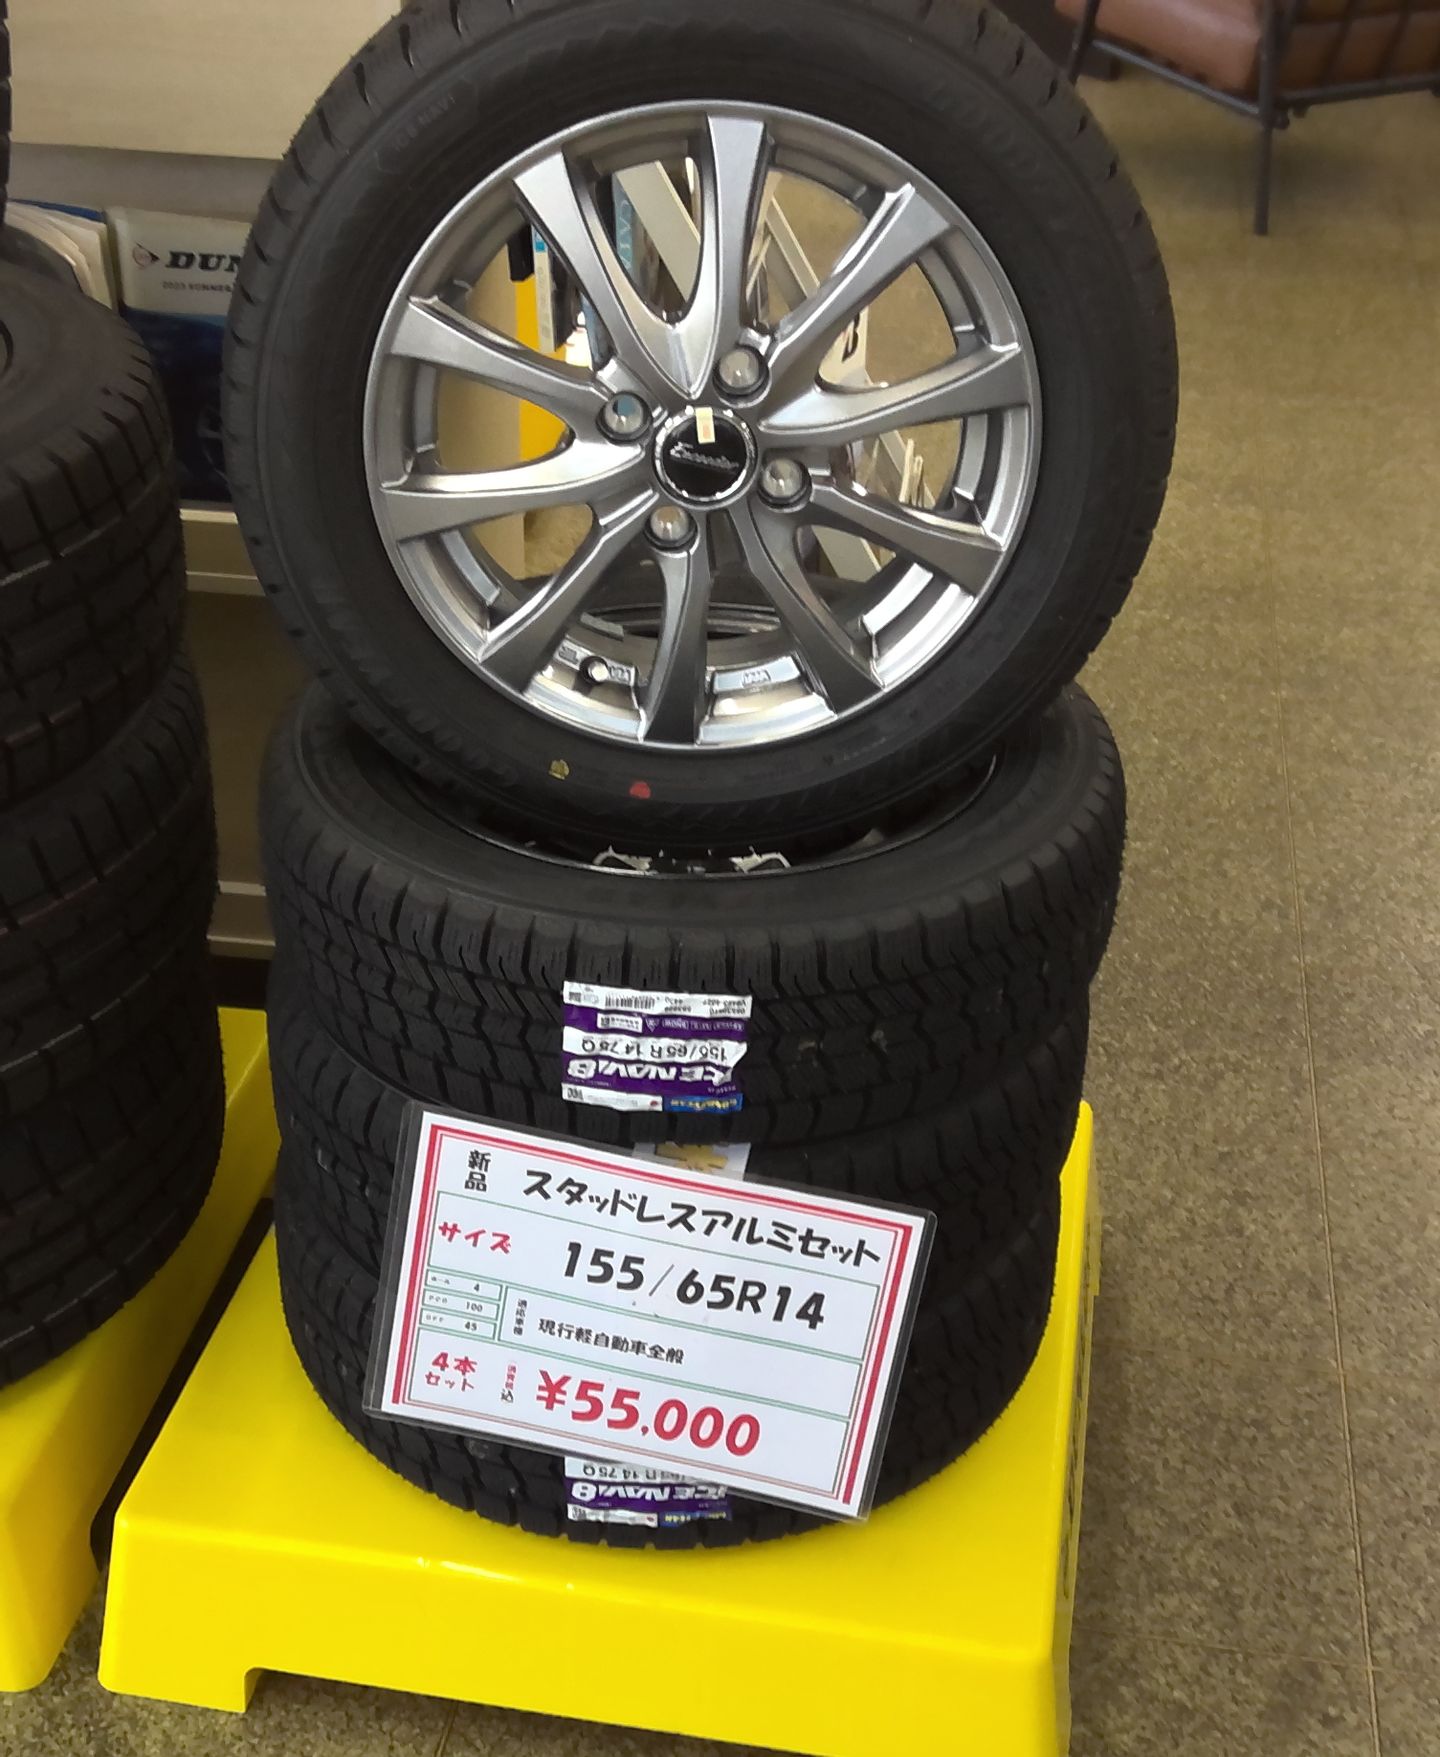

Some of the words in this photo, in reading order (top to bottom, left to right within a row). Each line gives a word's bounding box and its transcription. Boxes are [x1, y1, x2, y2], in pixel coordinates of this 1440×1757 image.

[464, 1149, 492, 1193] 新品
[523, 1168, 881, 1267] スタッドレスアルミセット
[438, 1221, 512, 1255] サイズ
[465, 1302, 484, 1313] 100
[537, 1317, 686, 1366] 現行軽自動車全般
[432, 1351, 479, 1377] 4本
[424, 1371, 476, 1394] セット
[536, 1369, 762, 1457] ¥55,000
